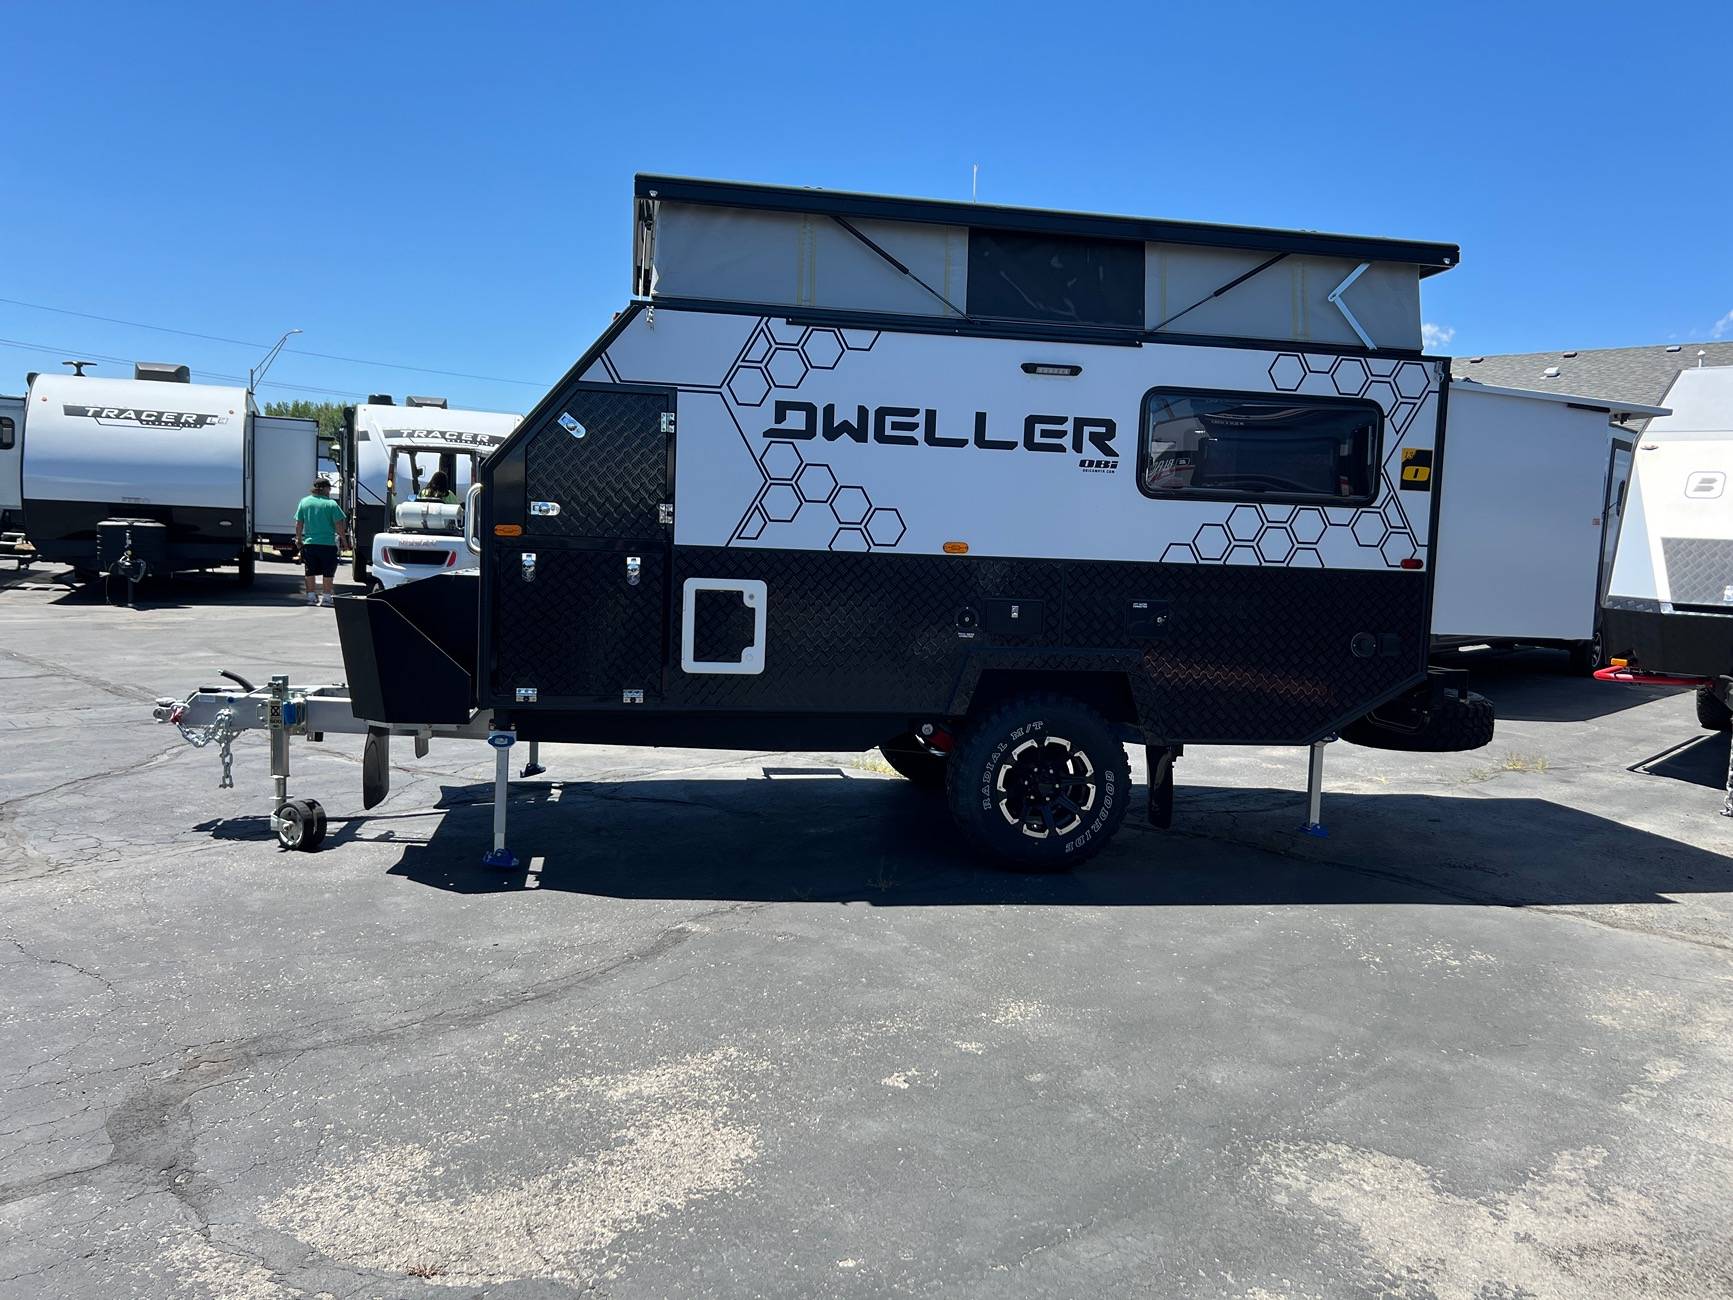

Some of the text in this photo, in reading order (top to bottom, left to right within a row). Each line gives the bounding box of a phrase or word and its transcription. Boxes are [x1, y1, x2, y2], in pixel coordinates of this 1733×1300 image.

[85, 407, 197, 423] TRACER
[400, 430, 489, 442] TRACER
[763, 400, 1120, 457] DWELLER
[982, 720, 1044, 810] RADIAL M/T
[1065, 770, 1115, 853] GOODRIDE
